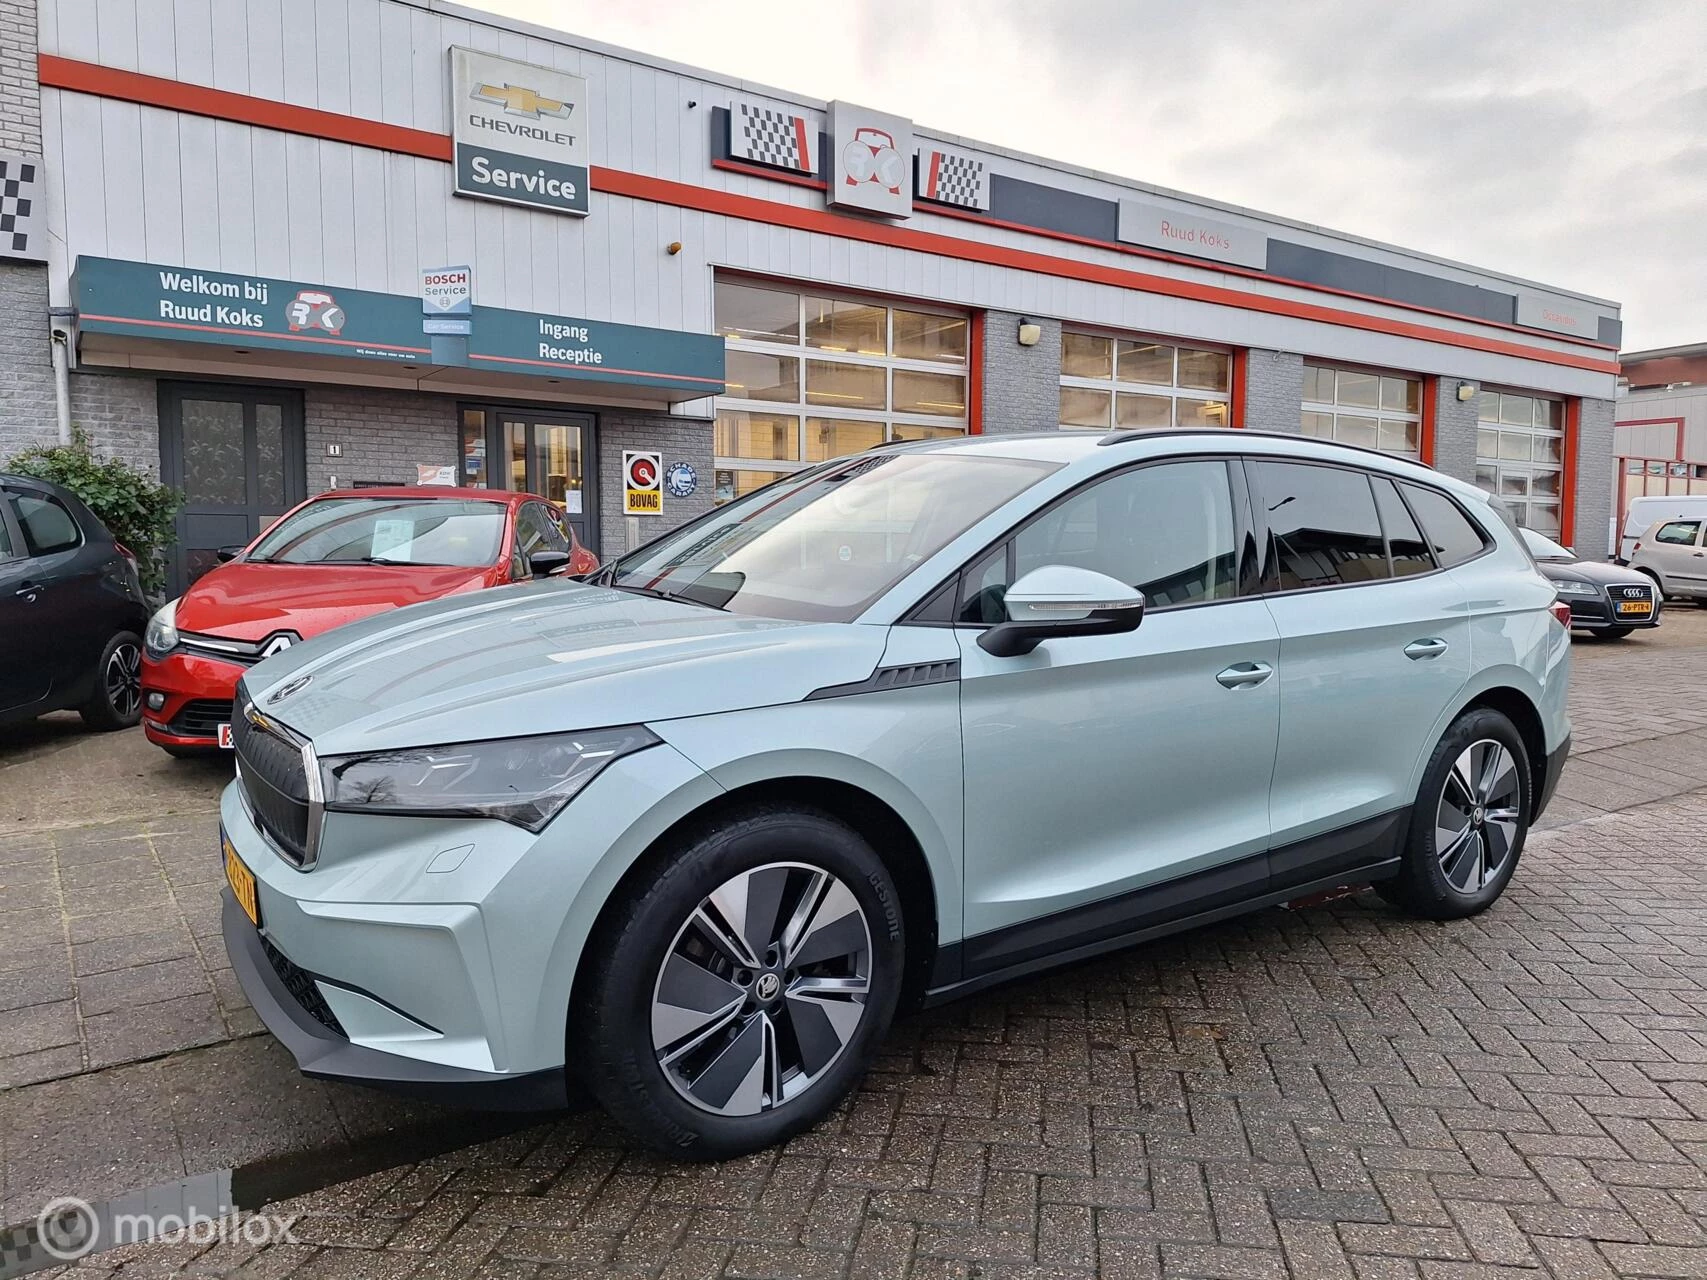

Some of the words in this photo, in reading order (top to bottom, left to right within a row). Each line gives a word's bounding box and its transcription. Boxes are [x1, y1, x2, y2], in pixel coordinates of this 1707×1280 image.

[469, 114, 577, 146] CHEVROLET
[471, 156, 576, 200] Service
[1161, 220, 1195, 241] Ruud
[1200, 230, 1230, 249] Koks
[159, 271, 240, 298] Welkom
[244, 281, 268, 305] bij
[424, 273, 466, 285] BOSCH
[425, 286, 467, 296] Service
[159, 299, 212, 322] Ruud
[216, 306, 264, 328] Koks
[539, 318, 589, 343] Ingang
[539, 342, 603, 365] Receptie
[629, 493, 658, 508] BOVAG
